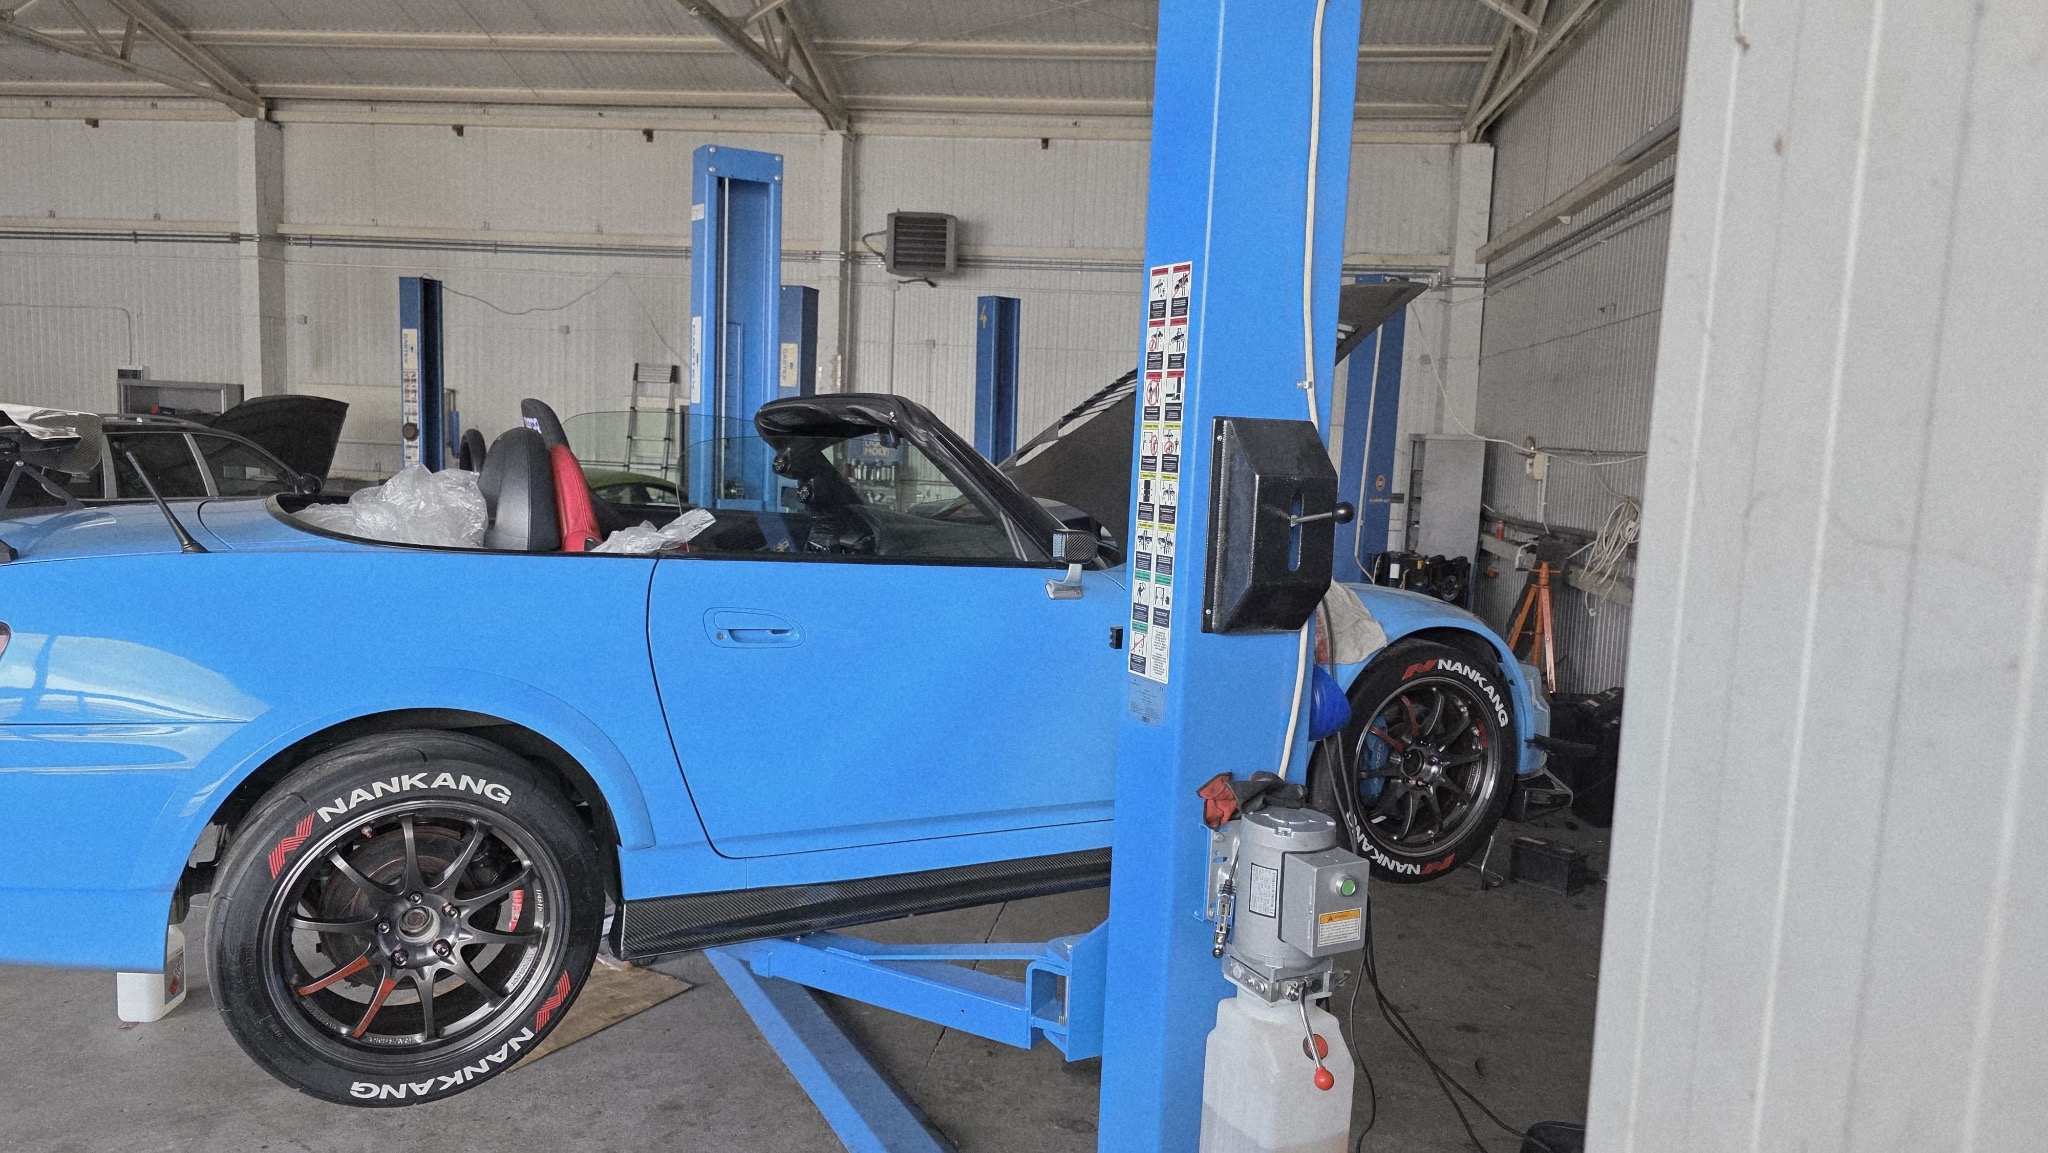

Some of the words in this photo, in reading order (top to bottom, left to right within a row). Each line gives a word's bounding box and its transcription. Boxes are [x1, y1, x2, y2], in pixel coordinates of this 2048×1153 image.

[1437, 659, 1509, 727] NANKANG
[317, 772, 512, 823] NANKANG
[349, 1026, 535, 1100] NANKANG
